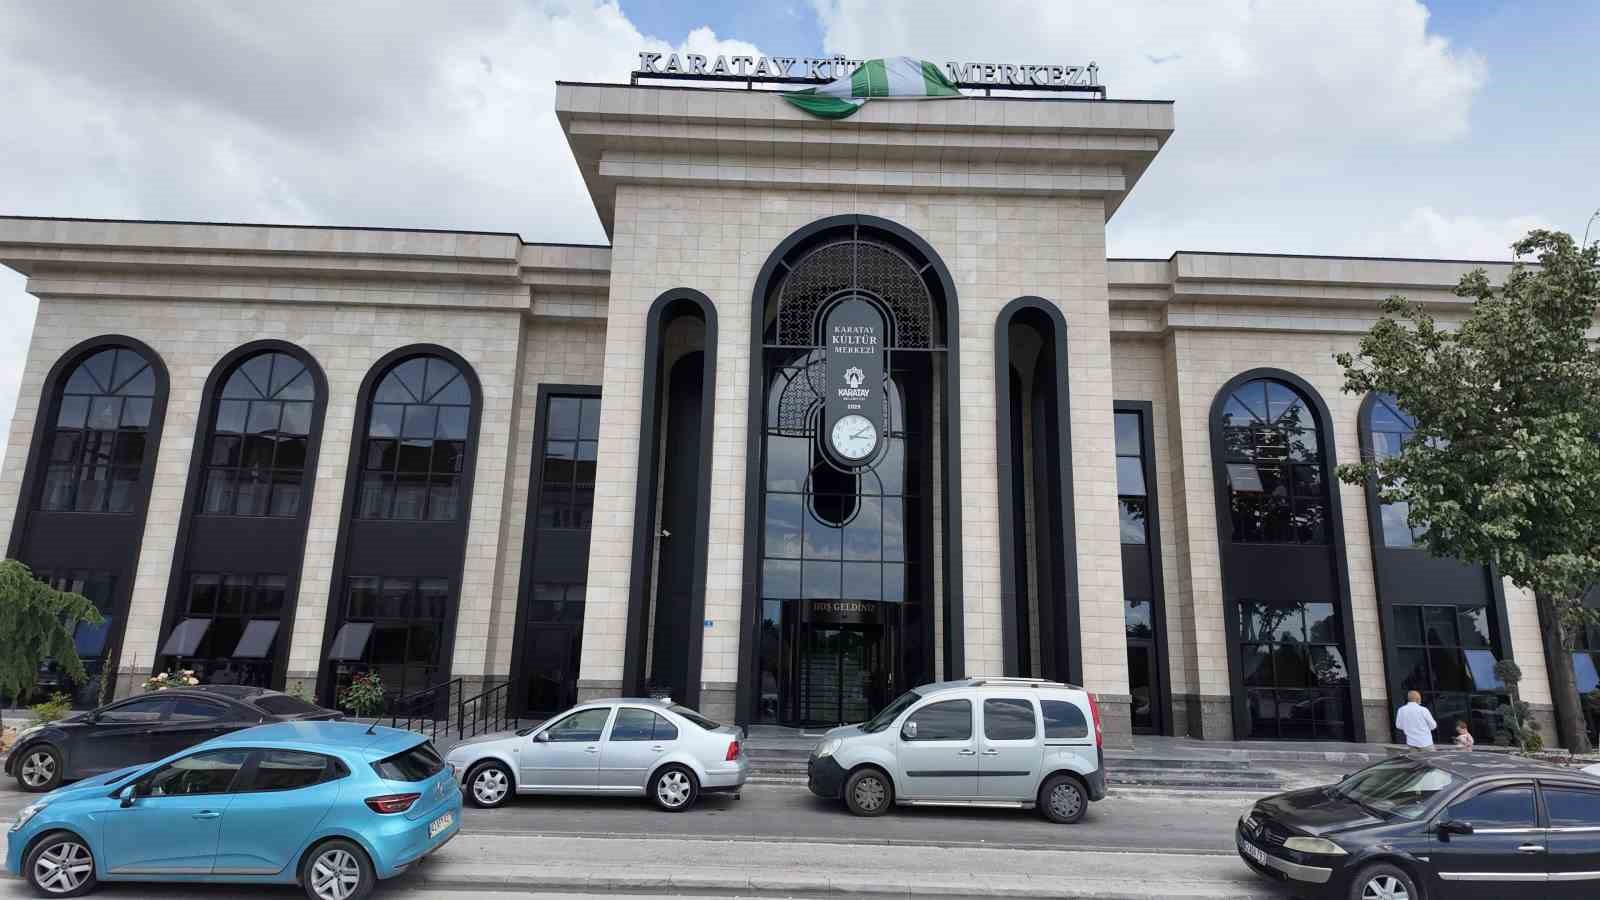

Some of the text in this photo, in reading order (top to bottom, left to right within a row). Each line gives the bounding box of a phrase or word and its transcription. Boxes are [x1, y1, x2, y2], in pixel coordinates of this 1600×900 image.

[639, 52, 796, 78] KARATAY
[947, 60, 1099, 87] MERKEZİ
[834, 326, 874, 334] KARATAY
[832, 334, 877, 344] KÜLTÜR
[834, 346, 874, 354] MERKEZİ
[838, 388, 870, 397] KARATAY
